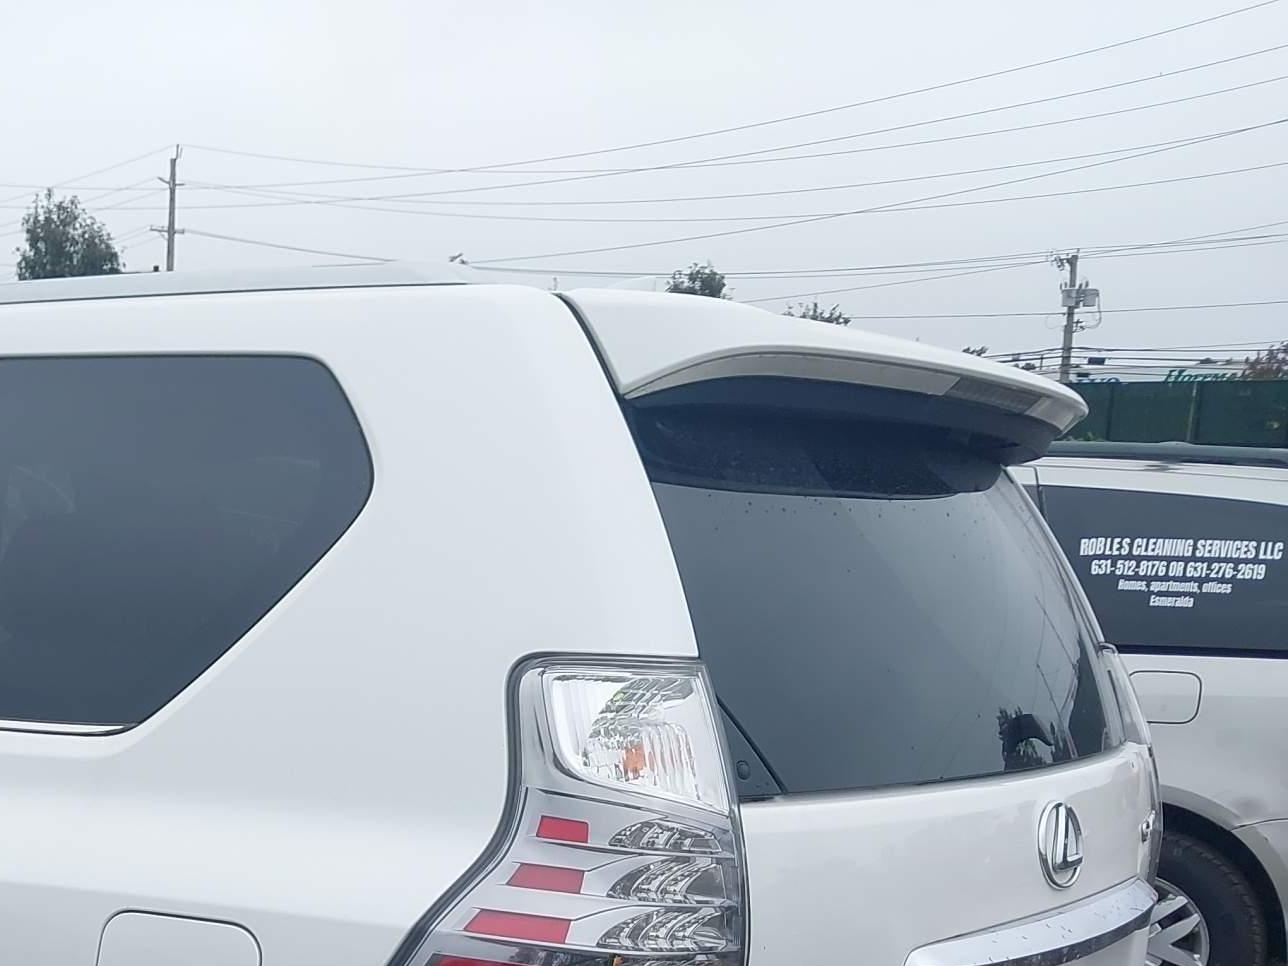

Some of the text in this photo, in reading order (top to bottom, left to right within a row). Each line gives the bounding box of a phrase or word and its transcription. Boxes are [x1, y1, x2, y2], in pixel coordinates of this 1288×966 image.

[1080, 537, 1284, 560] ROBLES CLEANING SERVICES LLC
[1091, 560, 1266, 579] 631-512-8176 OR 631-276-2619
[1117, 579, 1232, 594] Homes, apartments, offices
[1149, 595, 1194, 607] Esmeralda
